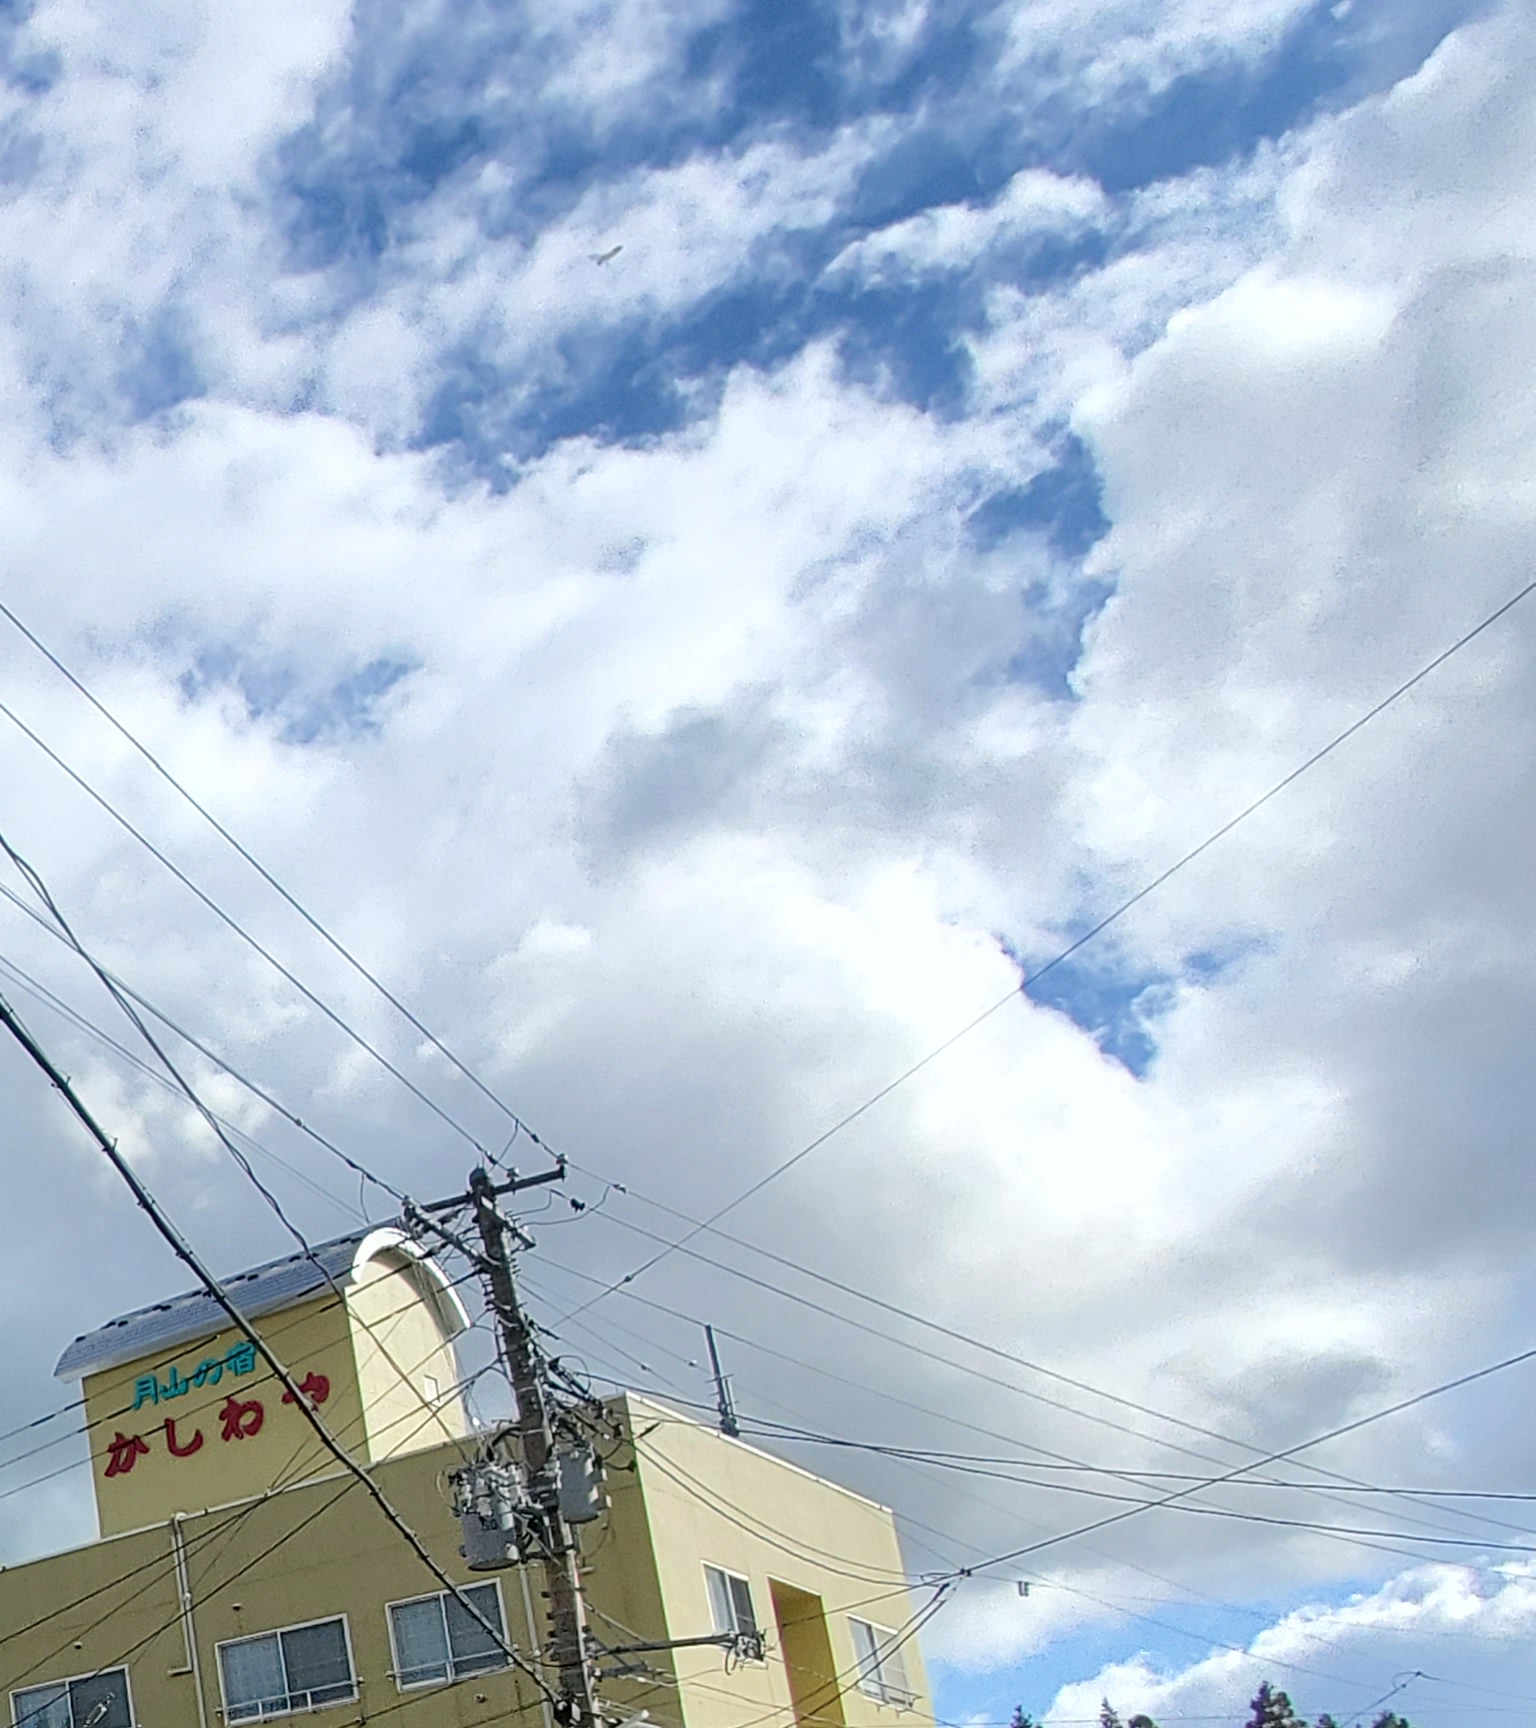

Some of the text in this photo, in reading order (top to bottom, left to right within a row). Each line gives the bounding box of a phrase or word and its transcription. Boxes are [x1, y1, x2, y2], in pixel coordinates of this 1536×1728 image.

[133, 1339, 257, 1411] 月山の宿
[104, 1372, 330, 1478] かしわや
